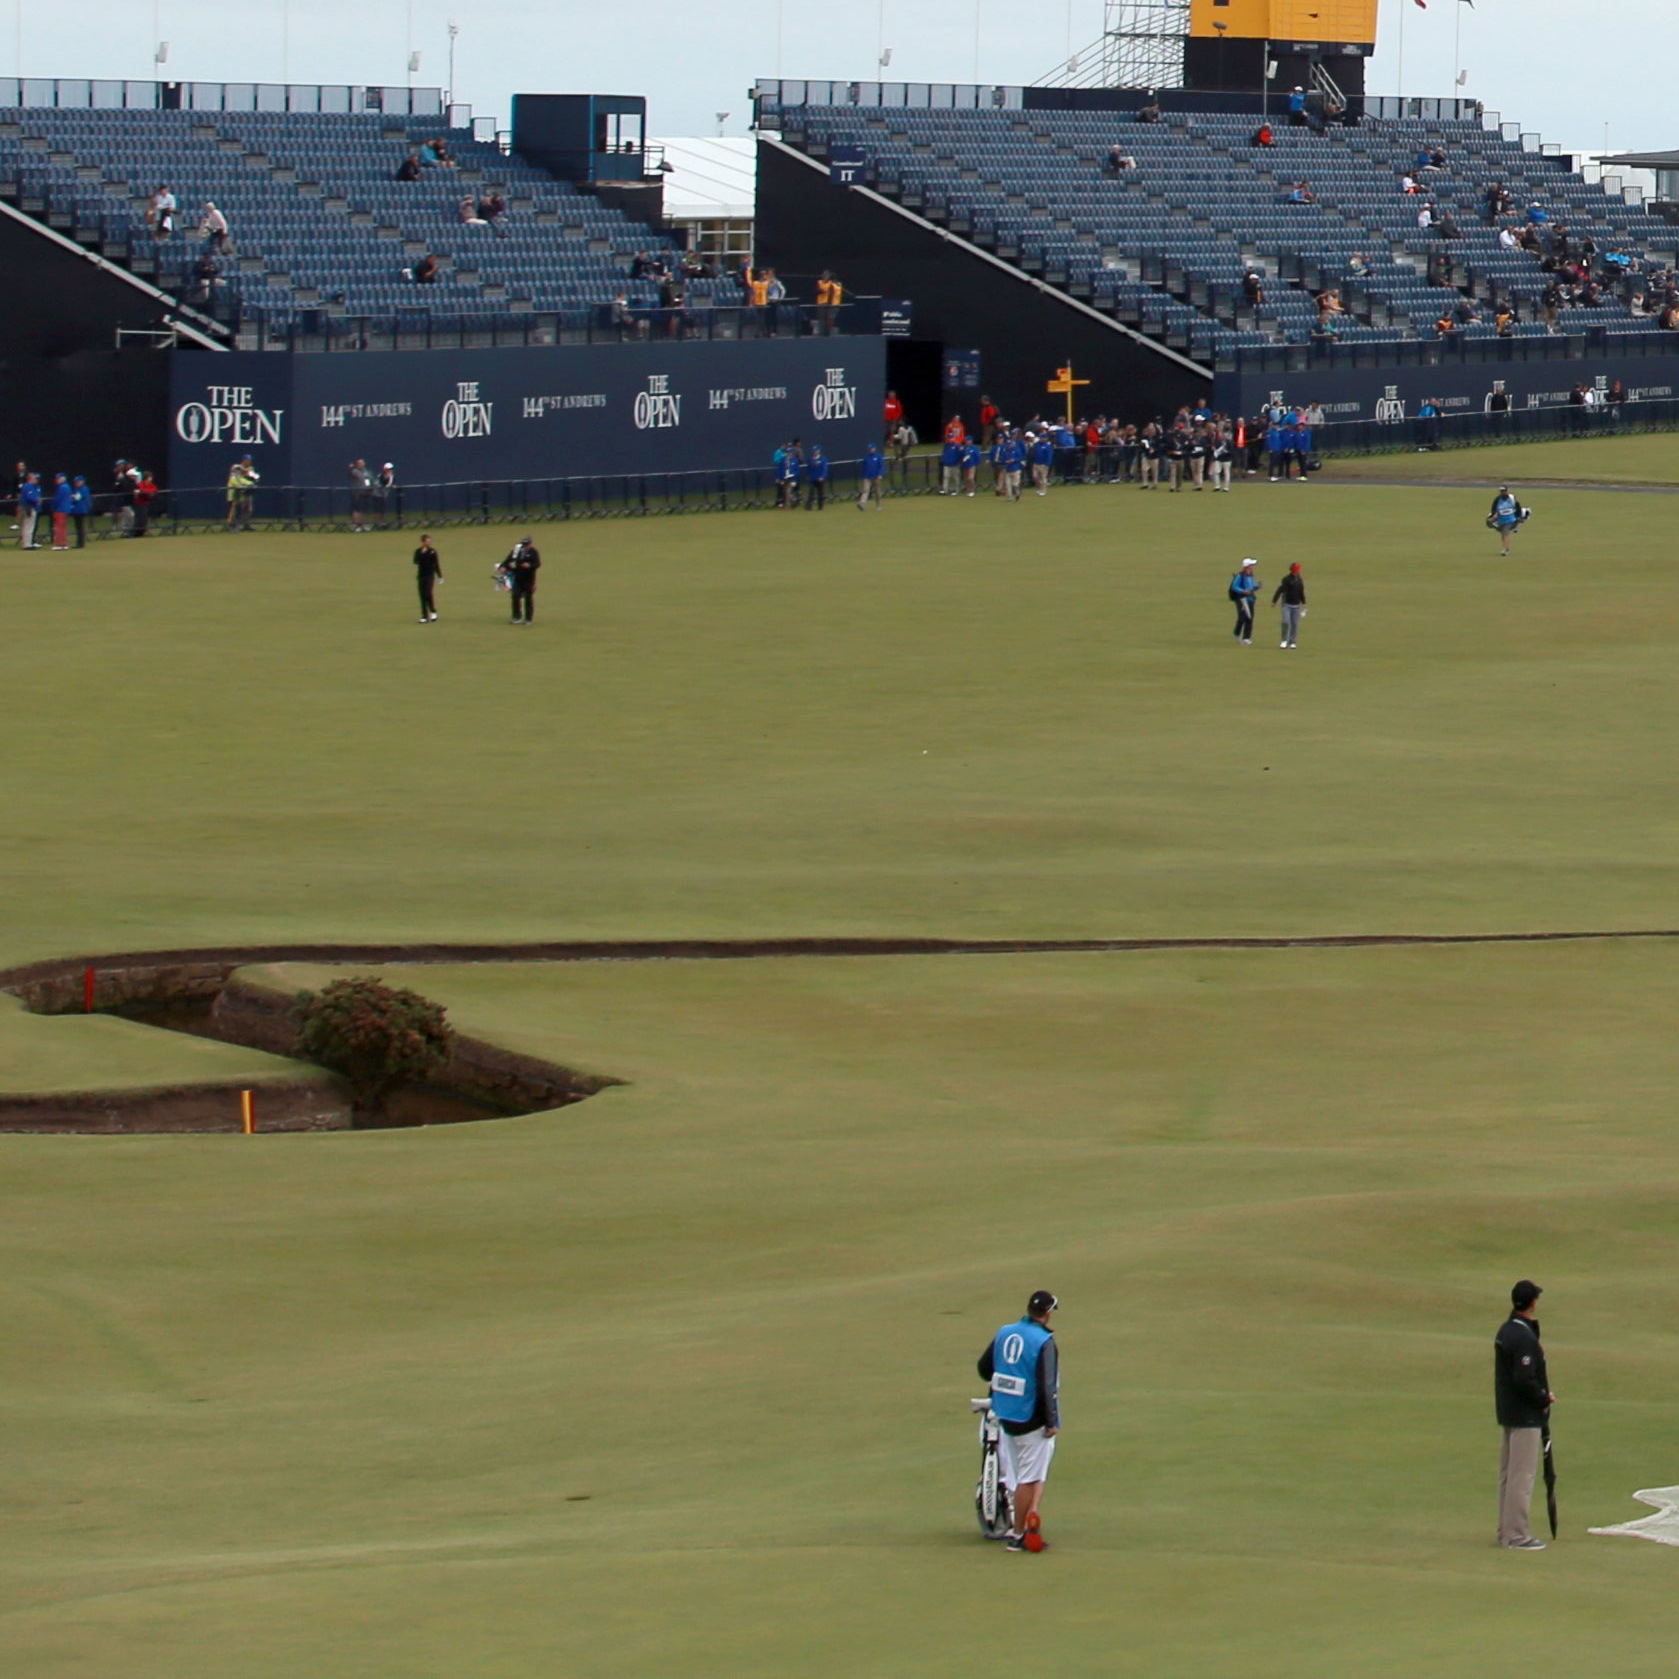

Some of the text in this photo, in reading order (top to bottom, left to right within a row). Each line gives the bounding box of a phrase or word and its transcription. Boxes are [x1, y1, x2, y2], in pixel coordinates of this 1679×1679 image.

[648, 375, 669, 394] THE
[825, 368, 845, 387] THE
[207, 386, 254, 407] THE
[457, 382, 480, 402] THE
[550, 396, 561, 409] ST
[563, 394, 606, 408] ANDREWS
[734, 388, 744, 402] ST
[746, 387, 787, 401] ANDREWS
[351, 405, 364, 418] ST
[366, 402, 413, 417] ANDREWS
[634, 391, 682, 430] OPEN
[812, 384, 857, 421] OPEN
[1375, 397, 1406, 425] OPEN
[176, 402, 284, 445] OPEN
[441, 399, 493, 439] OPEN
